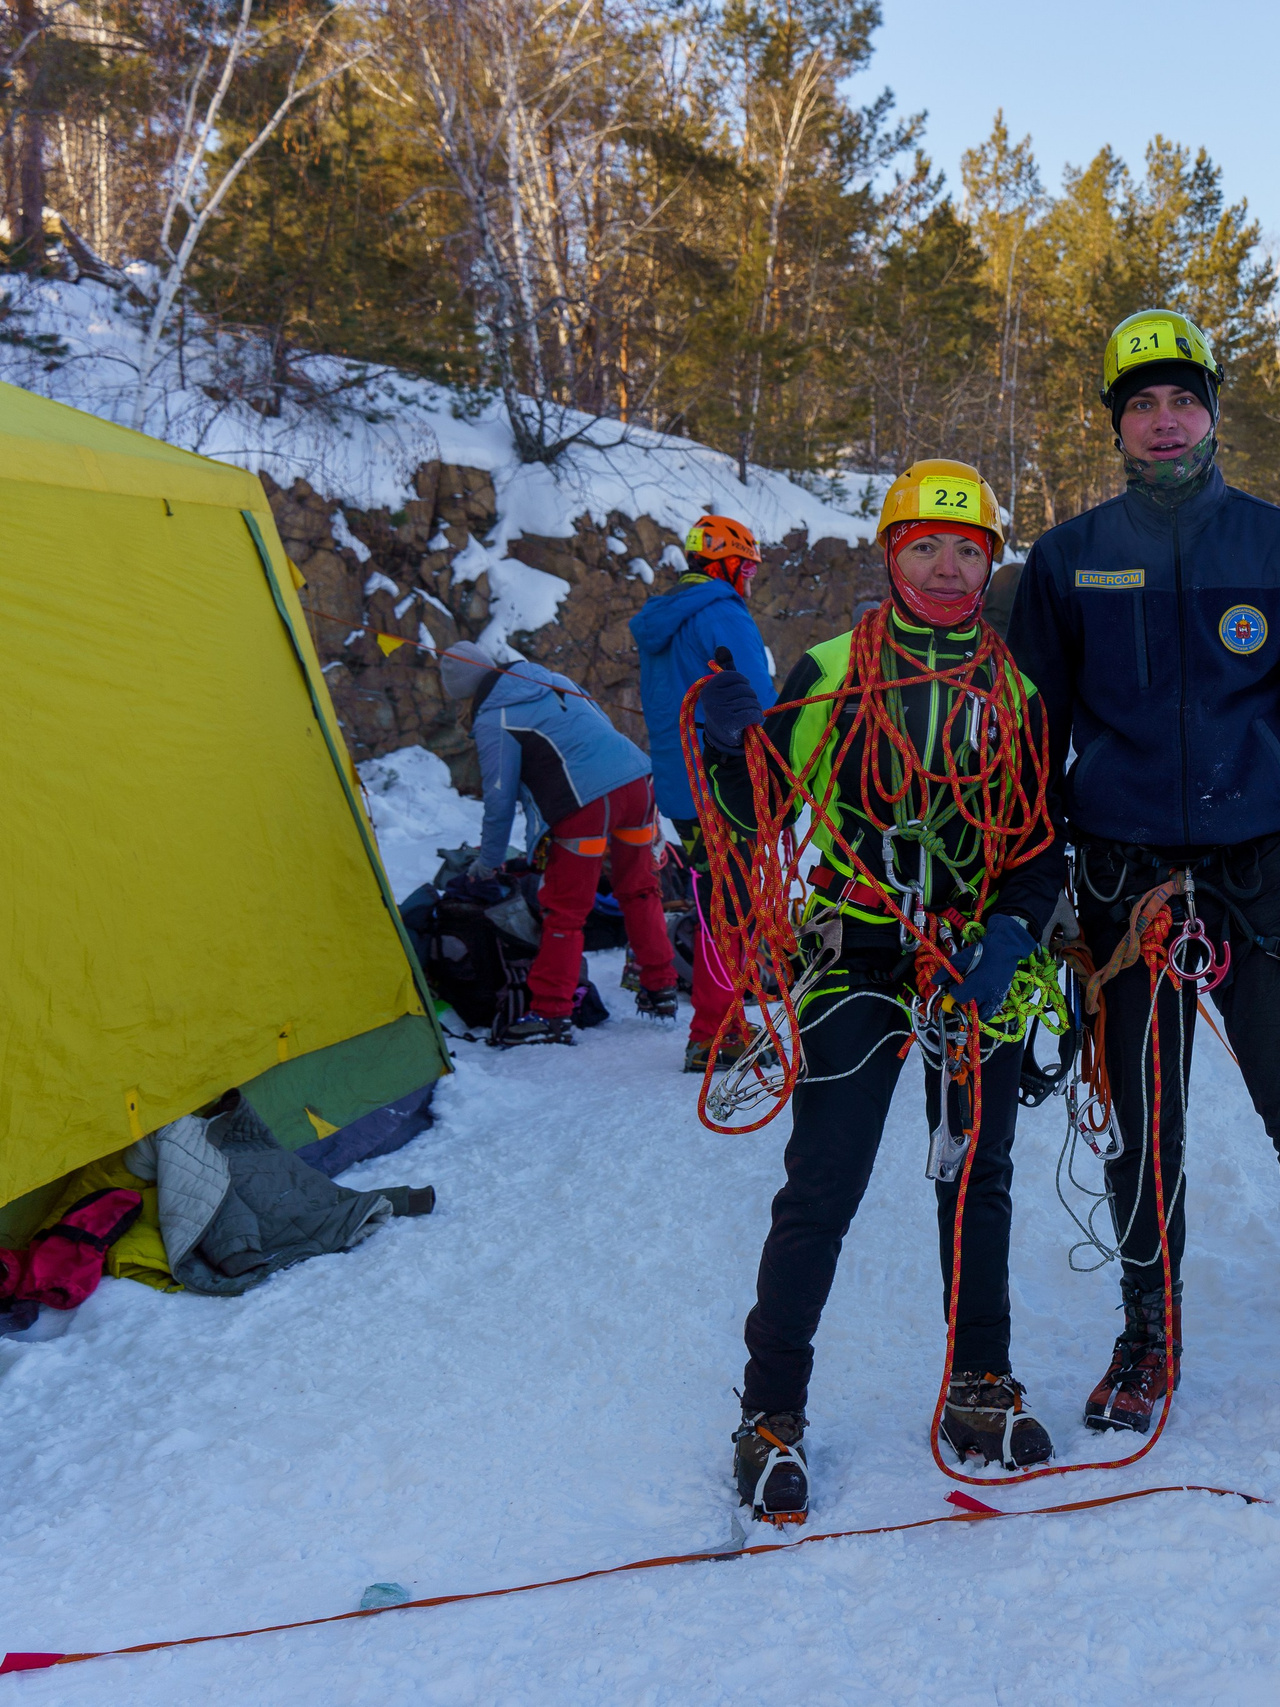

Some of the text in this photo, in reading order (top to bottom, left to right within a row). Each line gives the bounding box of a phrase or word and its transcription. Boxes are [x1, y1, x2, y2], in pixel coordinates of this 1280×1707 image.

[1130, 332, 1159, 354] 2.1
[935, 488, 968, 509] 2.2
[731, 540, 755, 558] VENTO
[1081, 574, 1140, 585] EMERCOM
